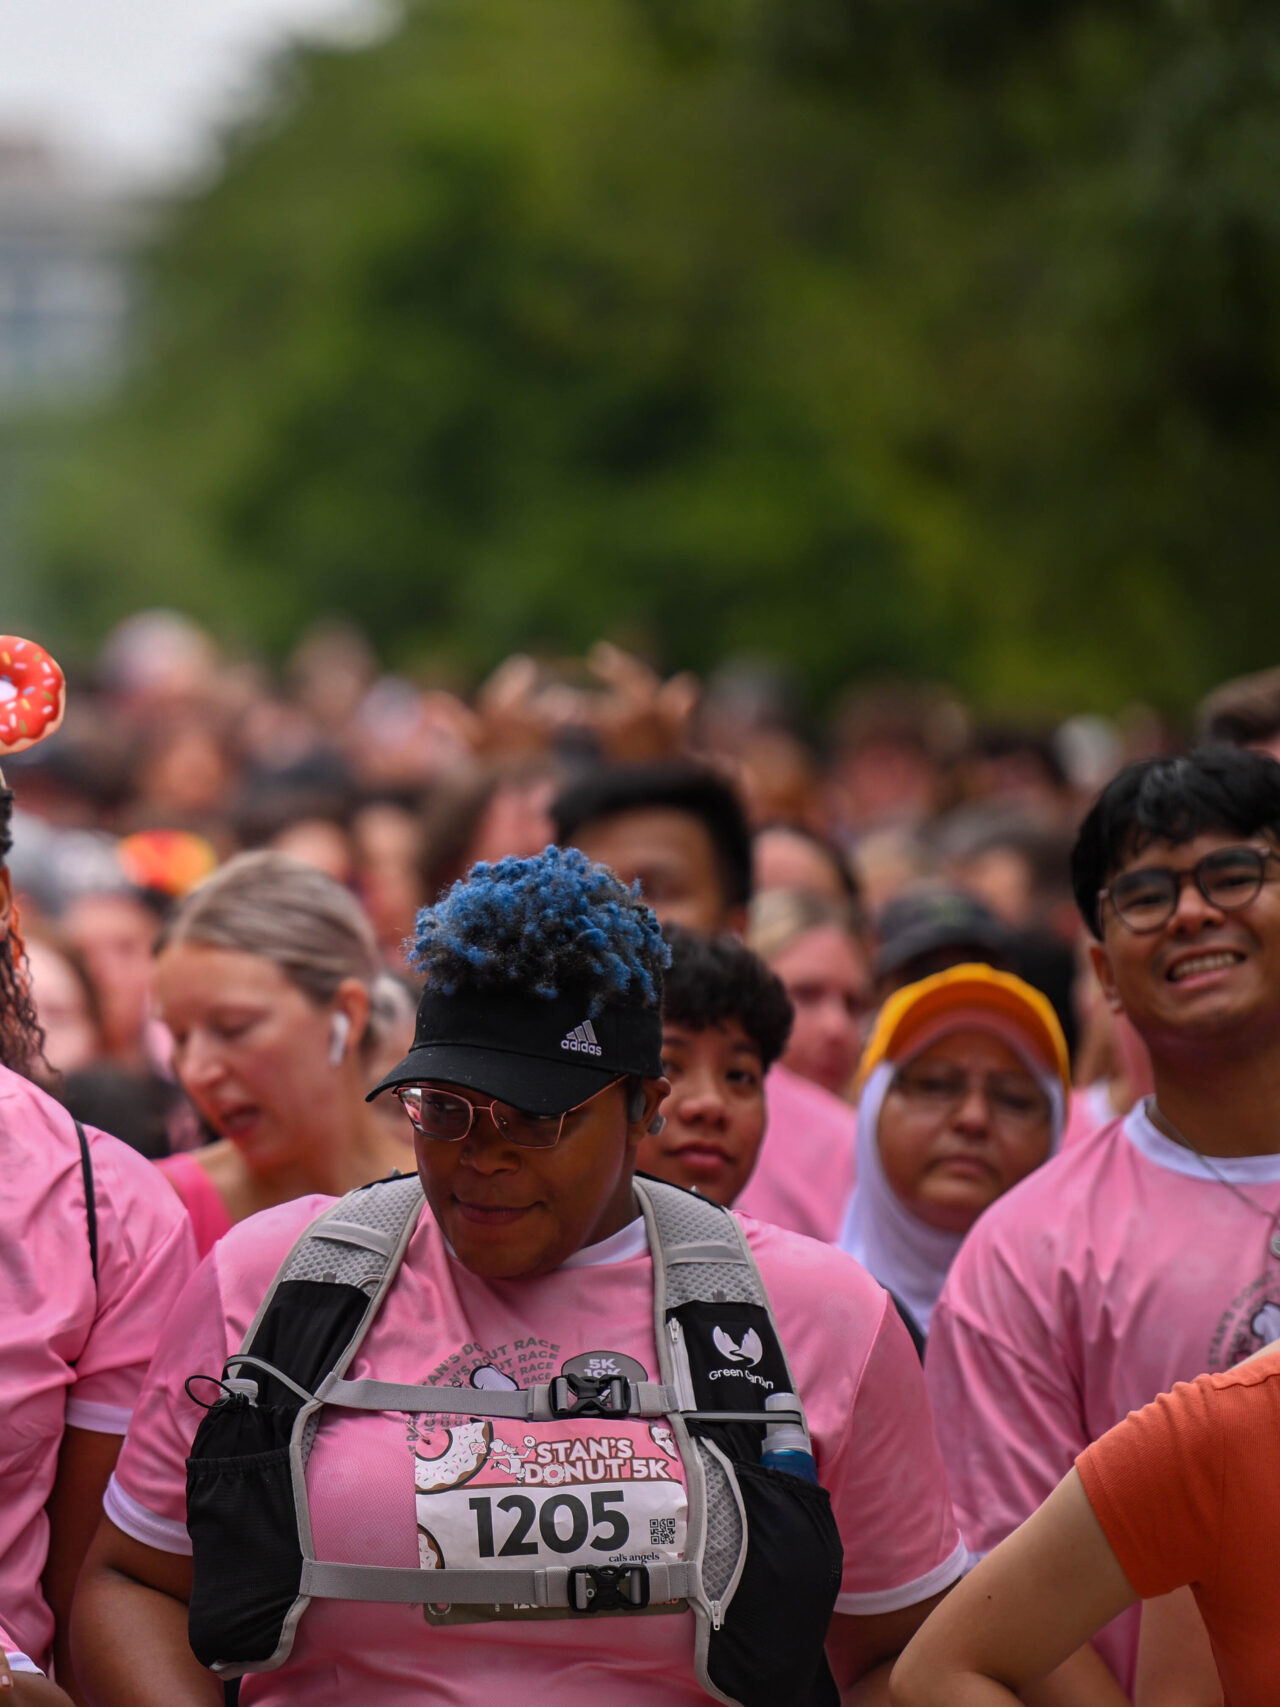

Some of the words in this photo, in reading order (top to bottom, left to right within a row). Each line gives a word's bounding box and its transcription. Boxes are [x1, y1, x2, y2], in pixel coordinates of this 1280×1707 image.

[560, 1038, 602, 1057] adidas
[423, 1353, 461, 1387] AN'S
[462, 1341, 508, 1360] DOUT
[513, 1337, 561, 1352] RACE
[518, 1350, 558, 1363] RACE
[520, 1362, 554, 1375] RACE
[589, 1358, 616, 1369] 5K
[523, 1373, 552, 1385] RACE
[709, 1369, 744, 1381] Green
[536, 1438, 633, 1464] STAN'S
[524, 1459, 626, 1485] DONUT
[632, 1459, 669, 1479] 5K
[468, 1490, 630, 1558] 1205
[609, 1553, 628, 1563] cal's
[629, 1552, 660, 1564] angels
